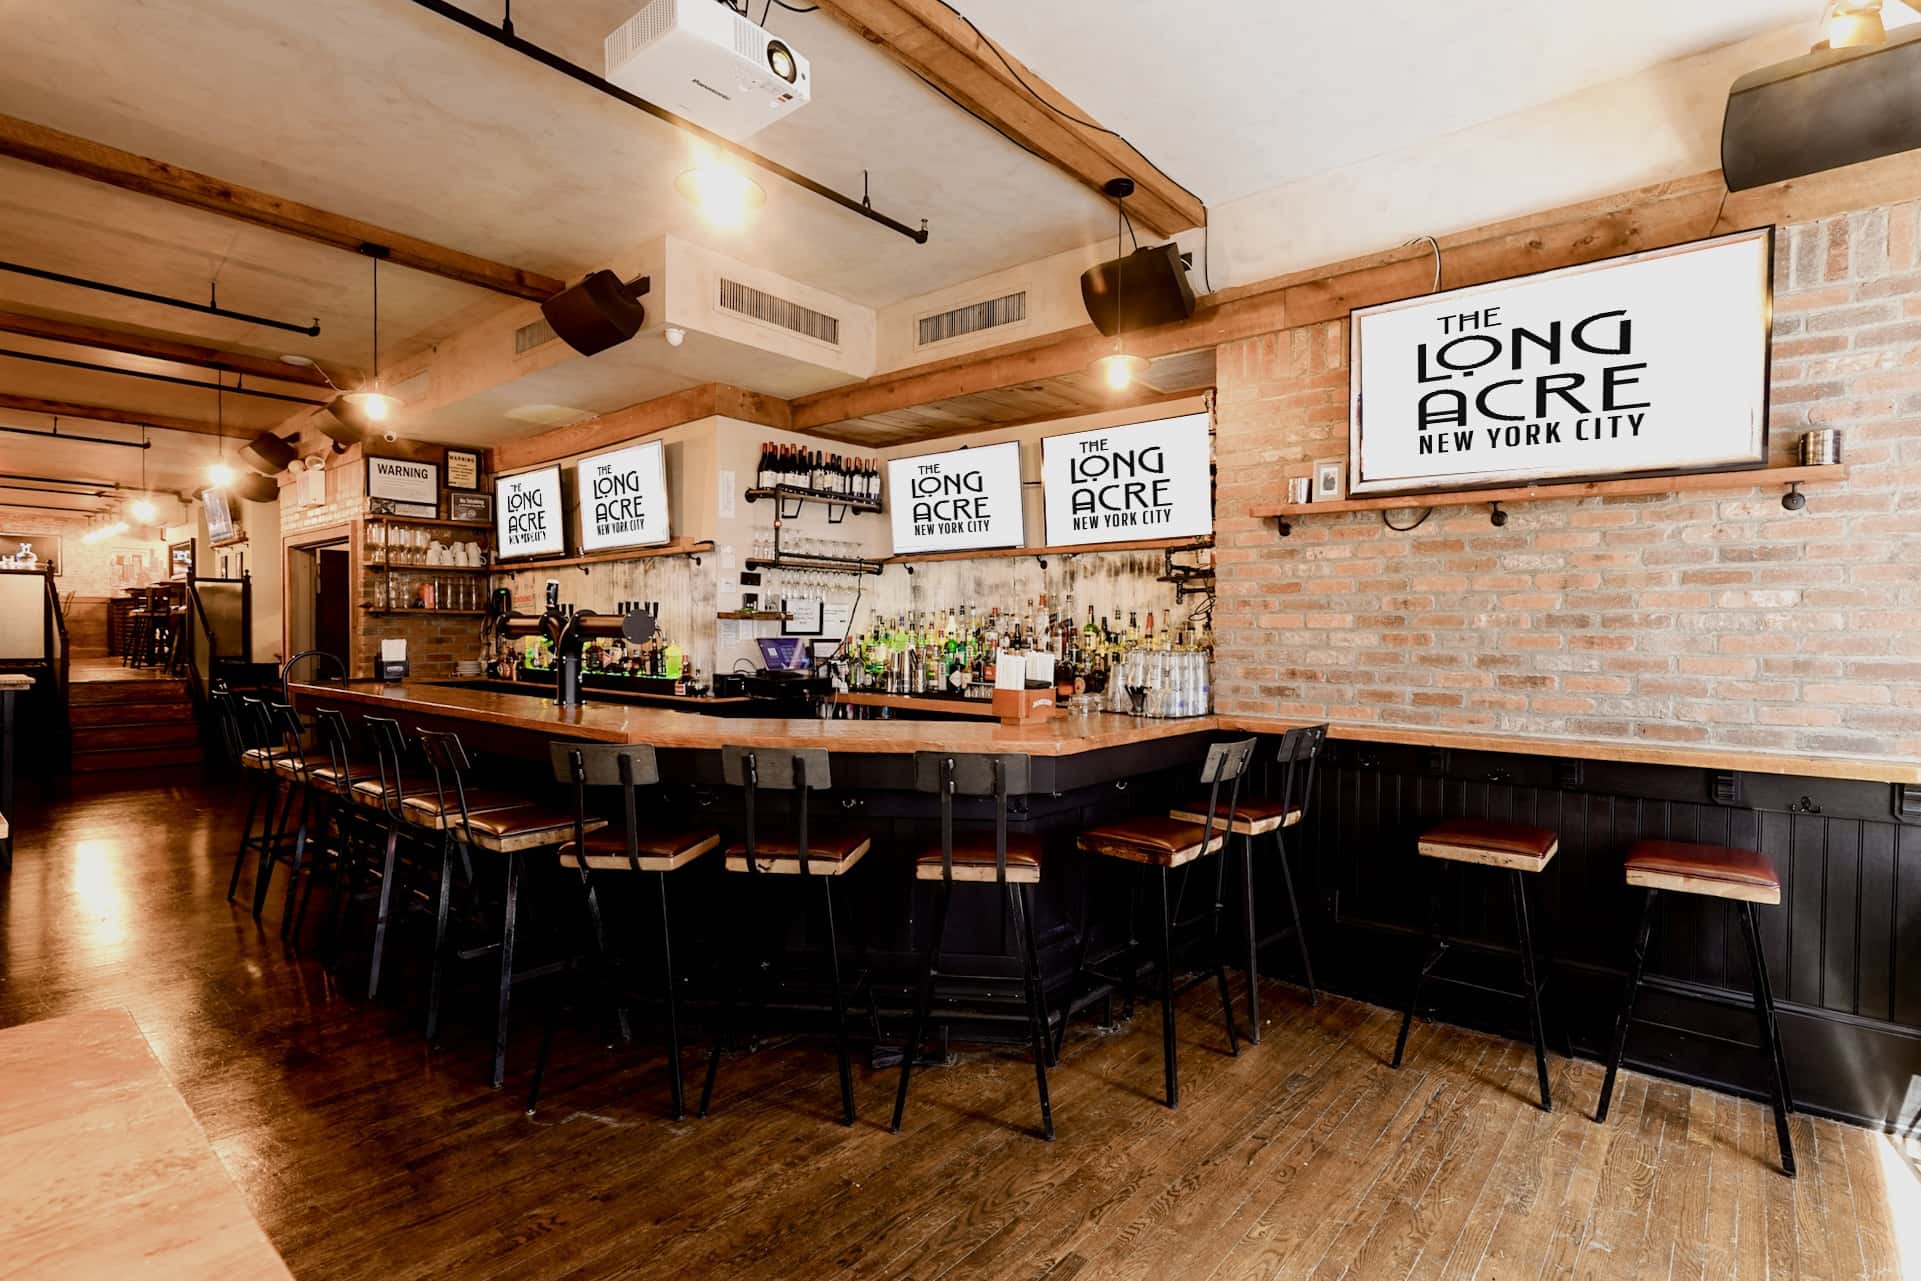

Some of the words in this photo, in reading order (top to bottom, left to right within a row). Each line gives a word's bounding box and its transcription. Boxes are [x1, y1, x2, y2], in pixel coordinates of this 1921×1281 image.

[1437, 307, 1502, 335] THE
[1418, 310, 1632, 384] LONG
[1418, 363, 1651, 431] ACRE
[1079, 438, 1109, 454] THE
[1420, 430, 1474, 455] NEW
[1487, 421, 1561, 448] YORK
[1576, 413, 1645, 441] CITY
[377, 463, 429, 480] WARNING
[597, 464, 613, 477] THE
[918, 463, 941, 476] THE
[1071, 446, 1164, 485] LONG
[593, 470, 640, 500] LONG
[911, 470, 983, 499] LONG
[1072, 478, 1174, 516] ACRE
[507, 489, 543, 513] LONG
[596, 495, 645, 524] ACRE
[913, 496, 991, 524] ACRE
[508, 511, 547, 534] ACRE
[597, 524, 610, 537] NEW
[613, 521, 629, 535] YORK
[630, 518, 645, 531] CITY
[914, 523, 935, 537] NEW
[938, 521, 964, 536] YORK
[967, 519, 990, 533] CITY
[1073, 515, 1099, 531] NEW
[1104, 511, 1137, 529] YORK
[1142, 508, 1172, 526] CITY
